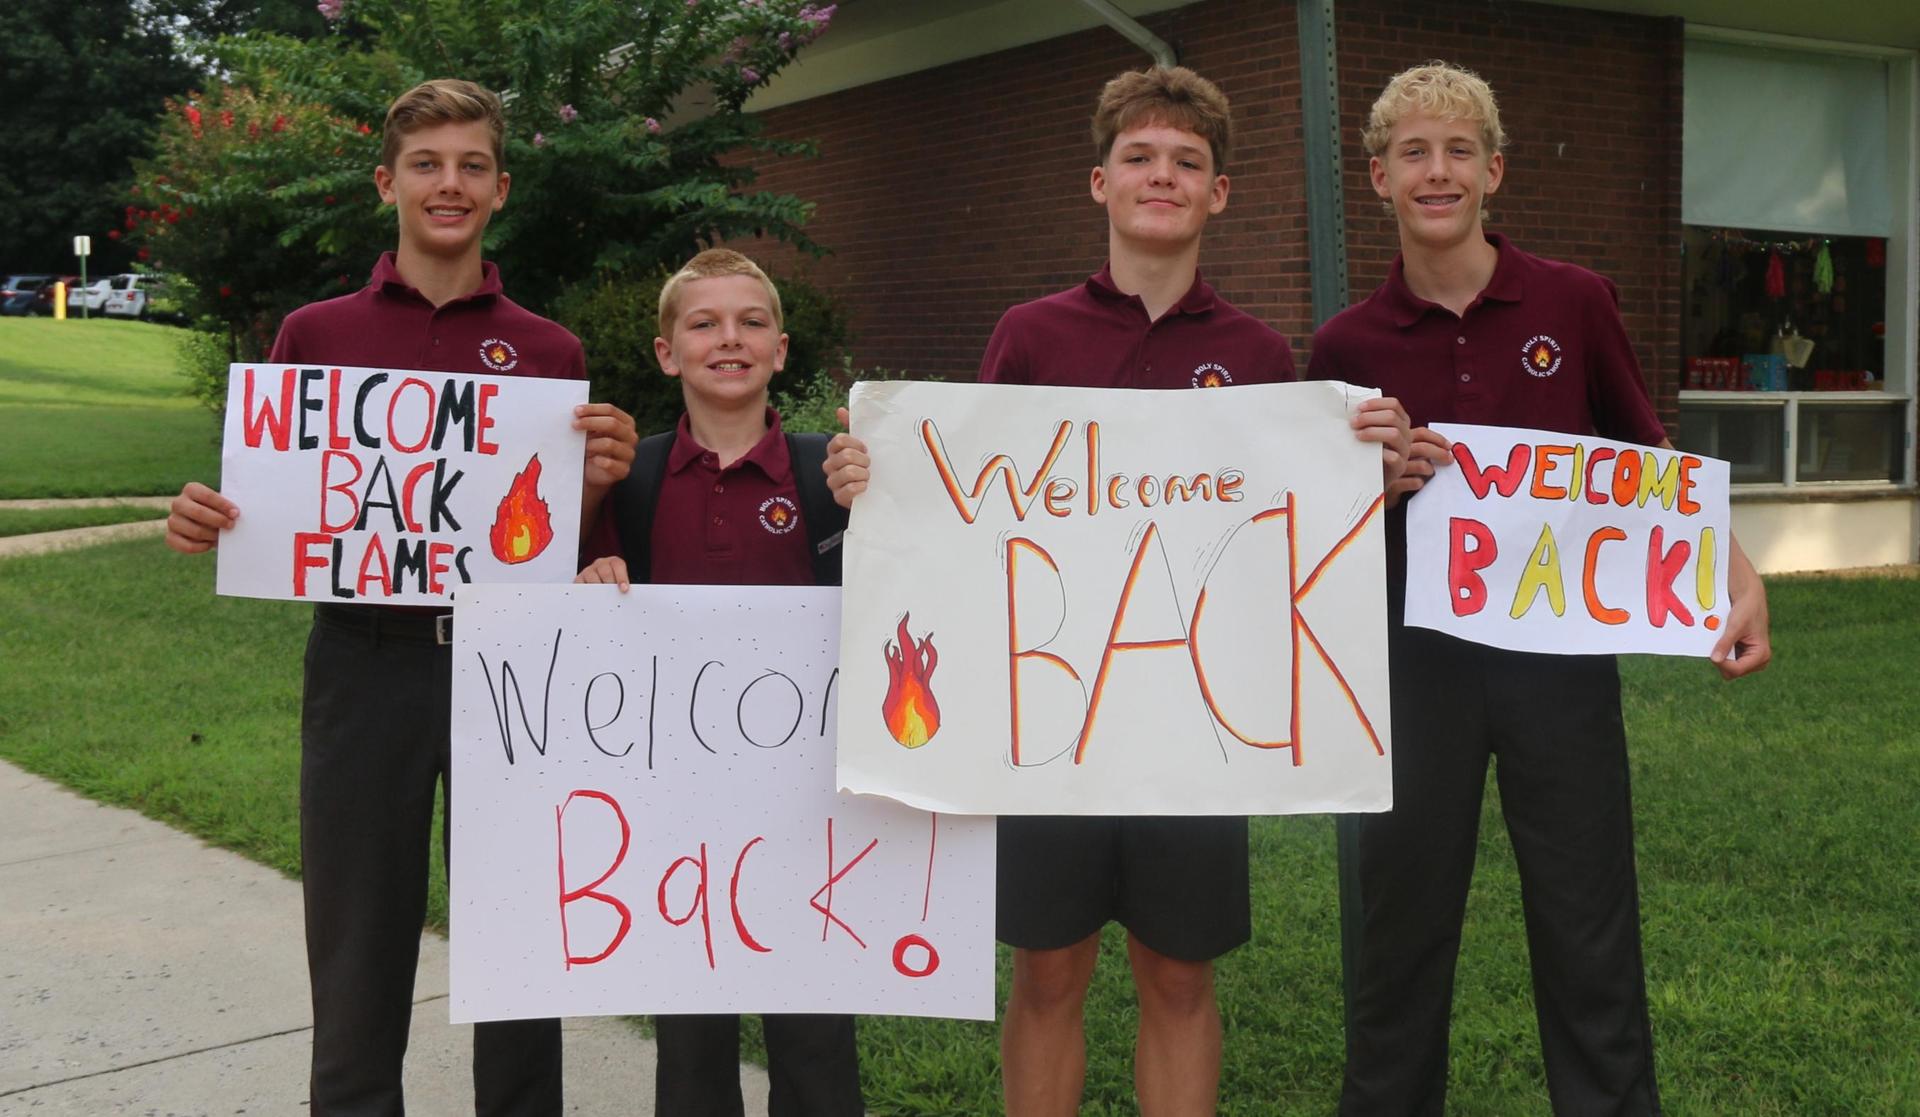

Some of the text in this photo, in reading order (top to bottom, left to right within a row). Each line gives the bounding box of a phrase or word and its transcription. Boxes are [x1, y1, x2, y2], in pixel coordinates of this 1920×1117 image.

[1194, 362, 1212, 376] HOLY
[1213, 363, 1233, 383] SPIRIT
[1521, 356, 1546, 377] CATHOLIC
[1522, 335, 1561, 353] HOLY SPIRIT
[243, 368, 500, 456] WELCOME
[320, 450, 465, 533] BACK
[759, 496, 797, 512] HOLY SPIRIT
[918, 418, 1246, 525] Welcome
[293, 532, 473, 600] FLAMES
[759, 514, 784, 535] CATHOLIC
[1448, 516, 1721, 631] BACK!
[1004, 489, 1386, 768] BACK
[477, 628, 840, 770] Welco
[555, 788, 941, 978] Back!
